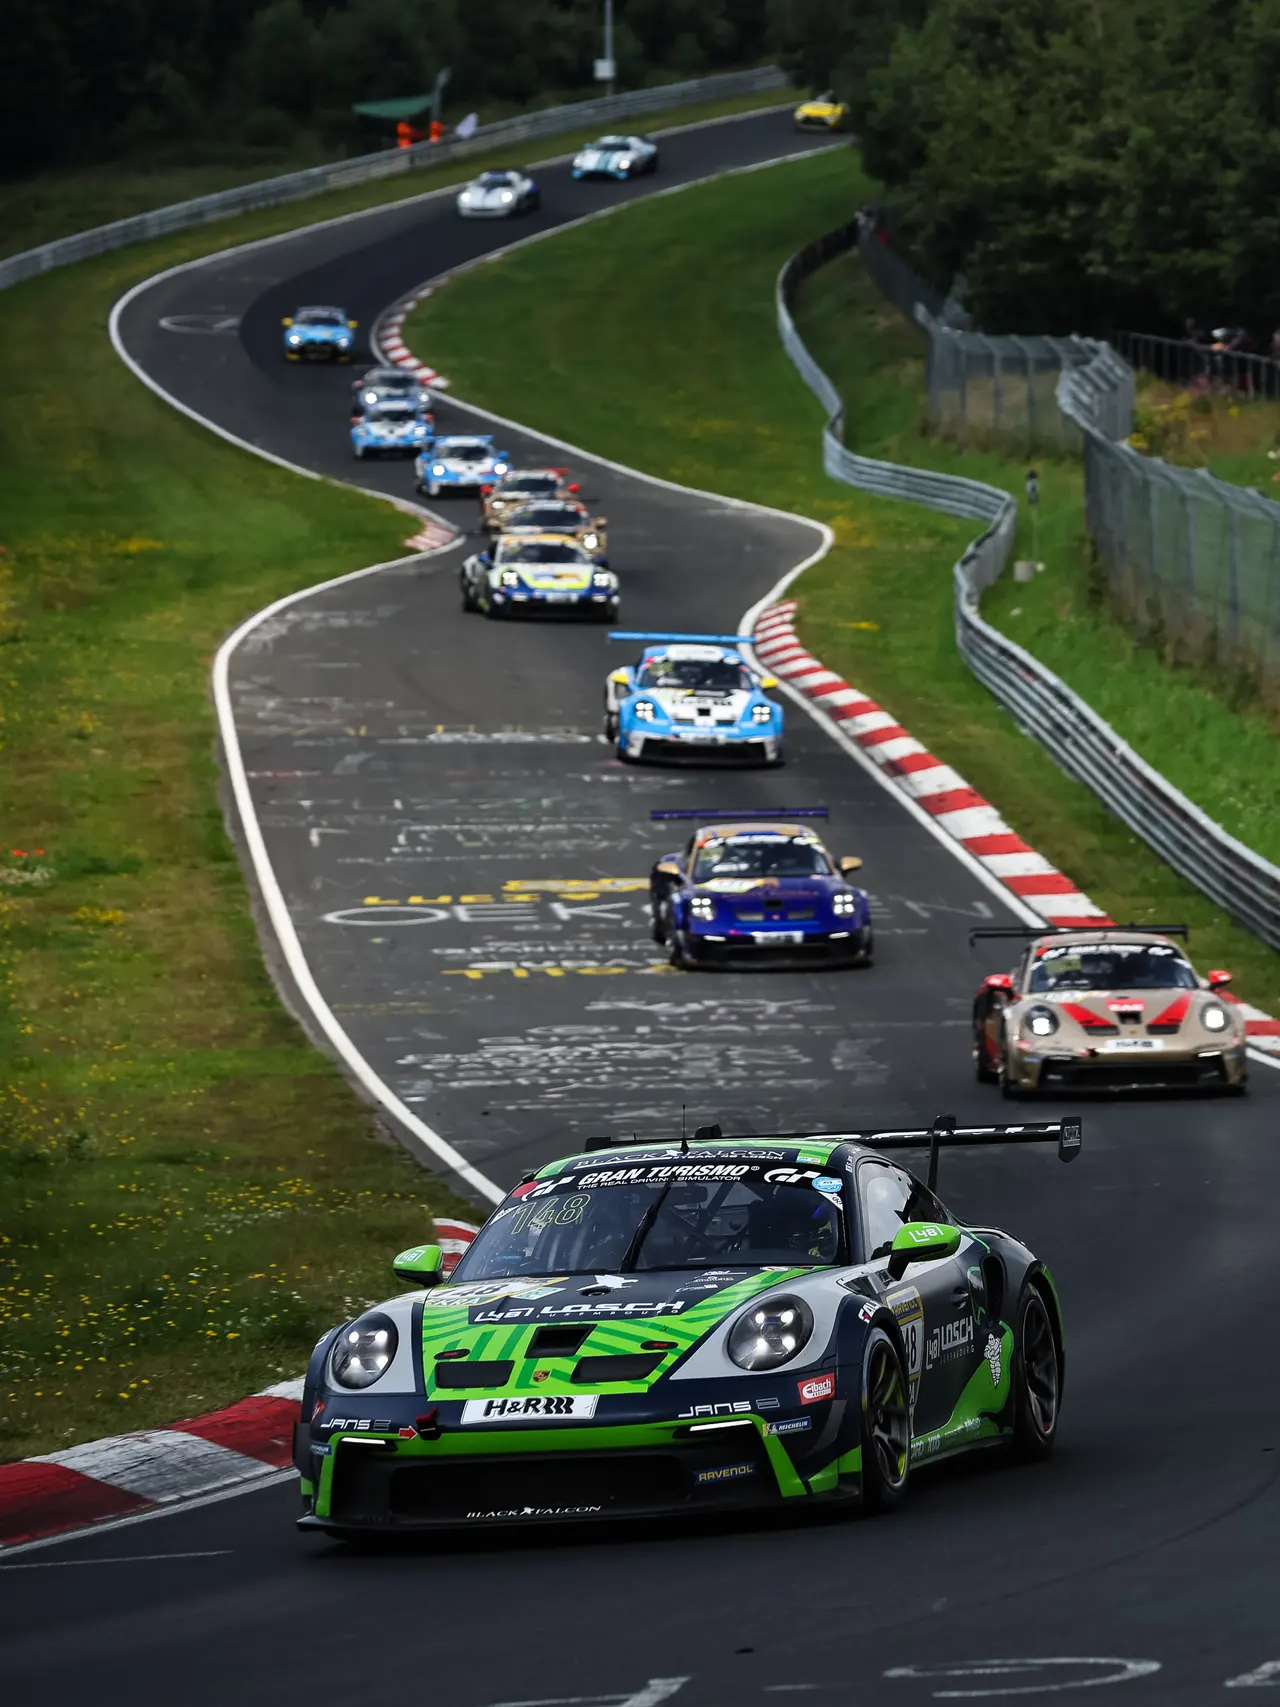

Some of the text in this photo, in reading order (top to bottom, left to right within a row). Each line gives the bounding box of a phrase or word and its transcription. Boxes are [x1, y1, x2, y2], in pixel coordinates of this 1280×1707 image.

[577, 1149, 787, 1167] BLACK FALCON
[578, 1164, 750, 1185] GRAN TURISMO
[577, 1183, 598, 1191] THE
[599, 1180, 629, 1188] REAL
[630, 1176, 676, 1184] DRIVIN
[511, 1193, 592, 1236] 148
[541, 1300, 686, 1315] LOSCH
[941, 1316, 974, 1351] LOSCH
[802, 1377, 832, 1399] Eibach
[778, 1420, 808, 1431] MICHELIN
[698, 1464, 753, 1481] RAVENOL
[466, 1505, 602, 1519] BLACK FALCON
